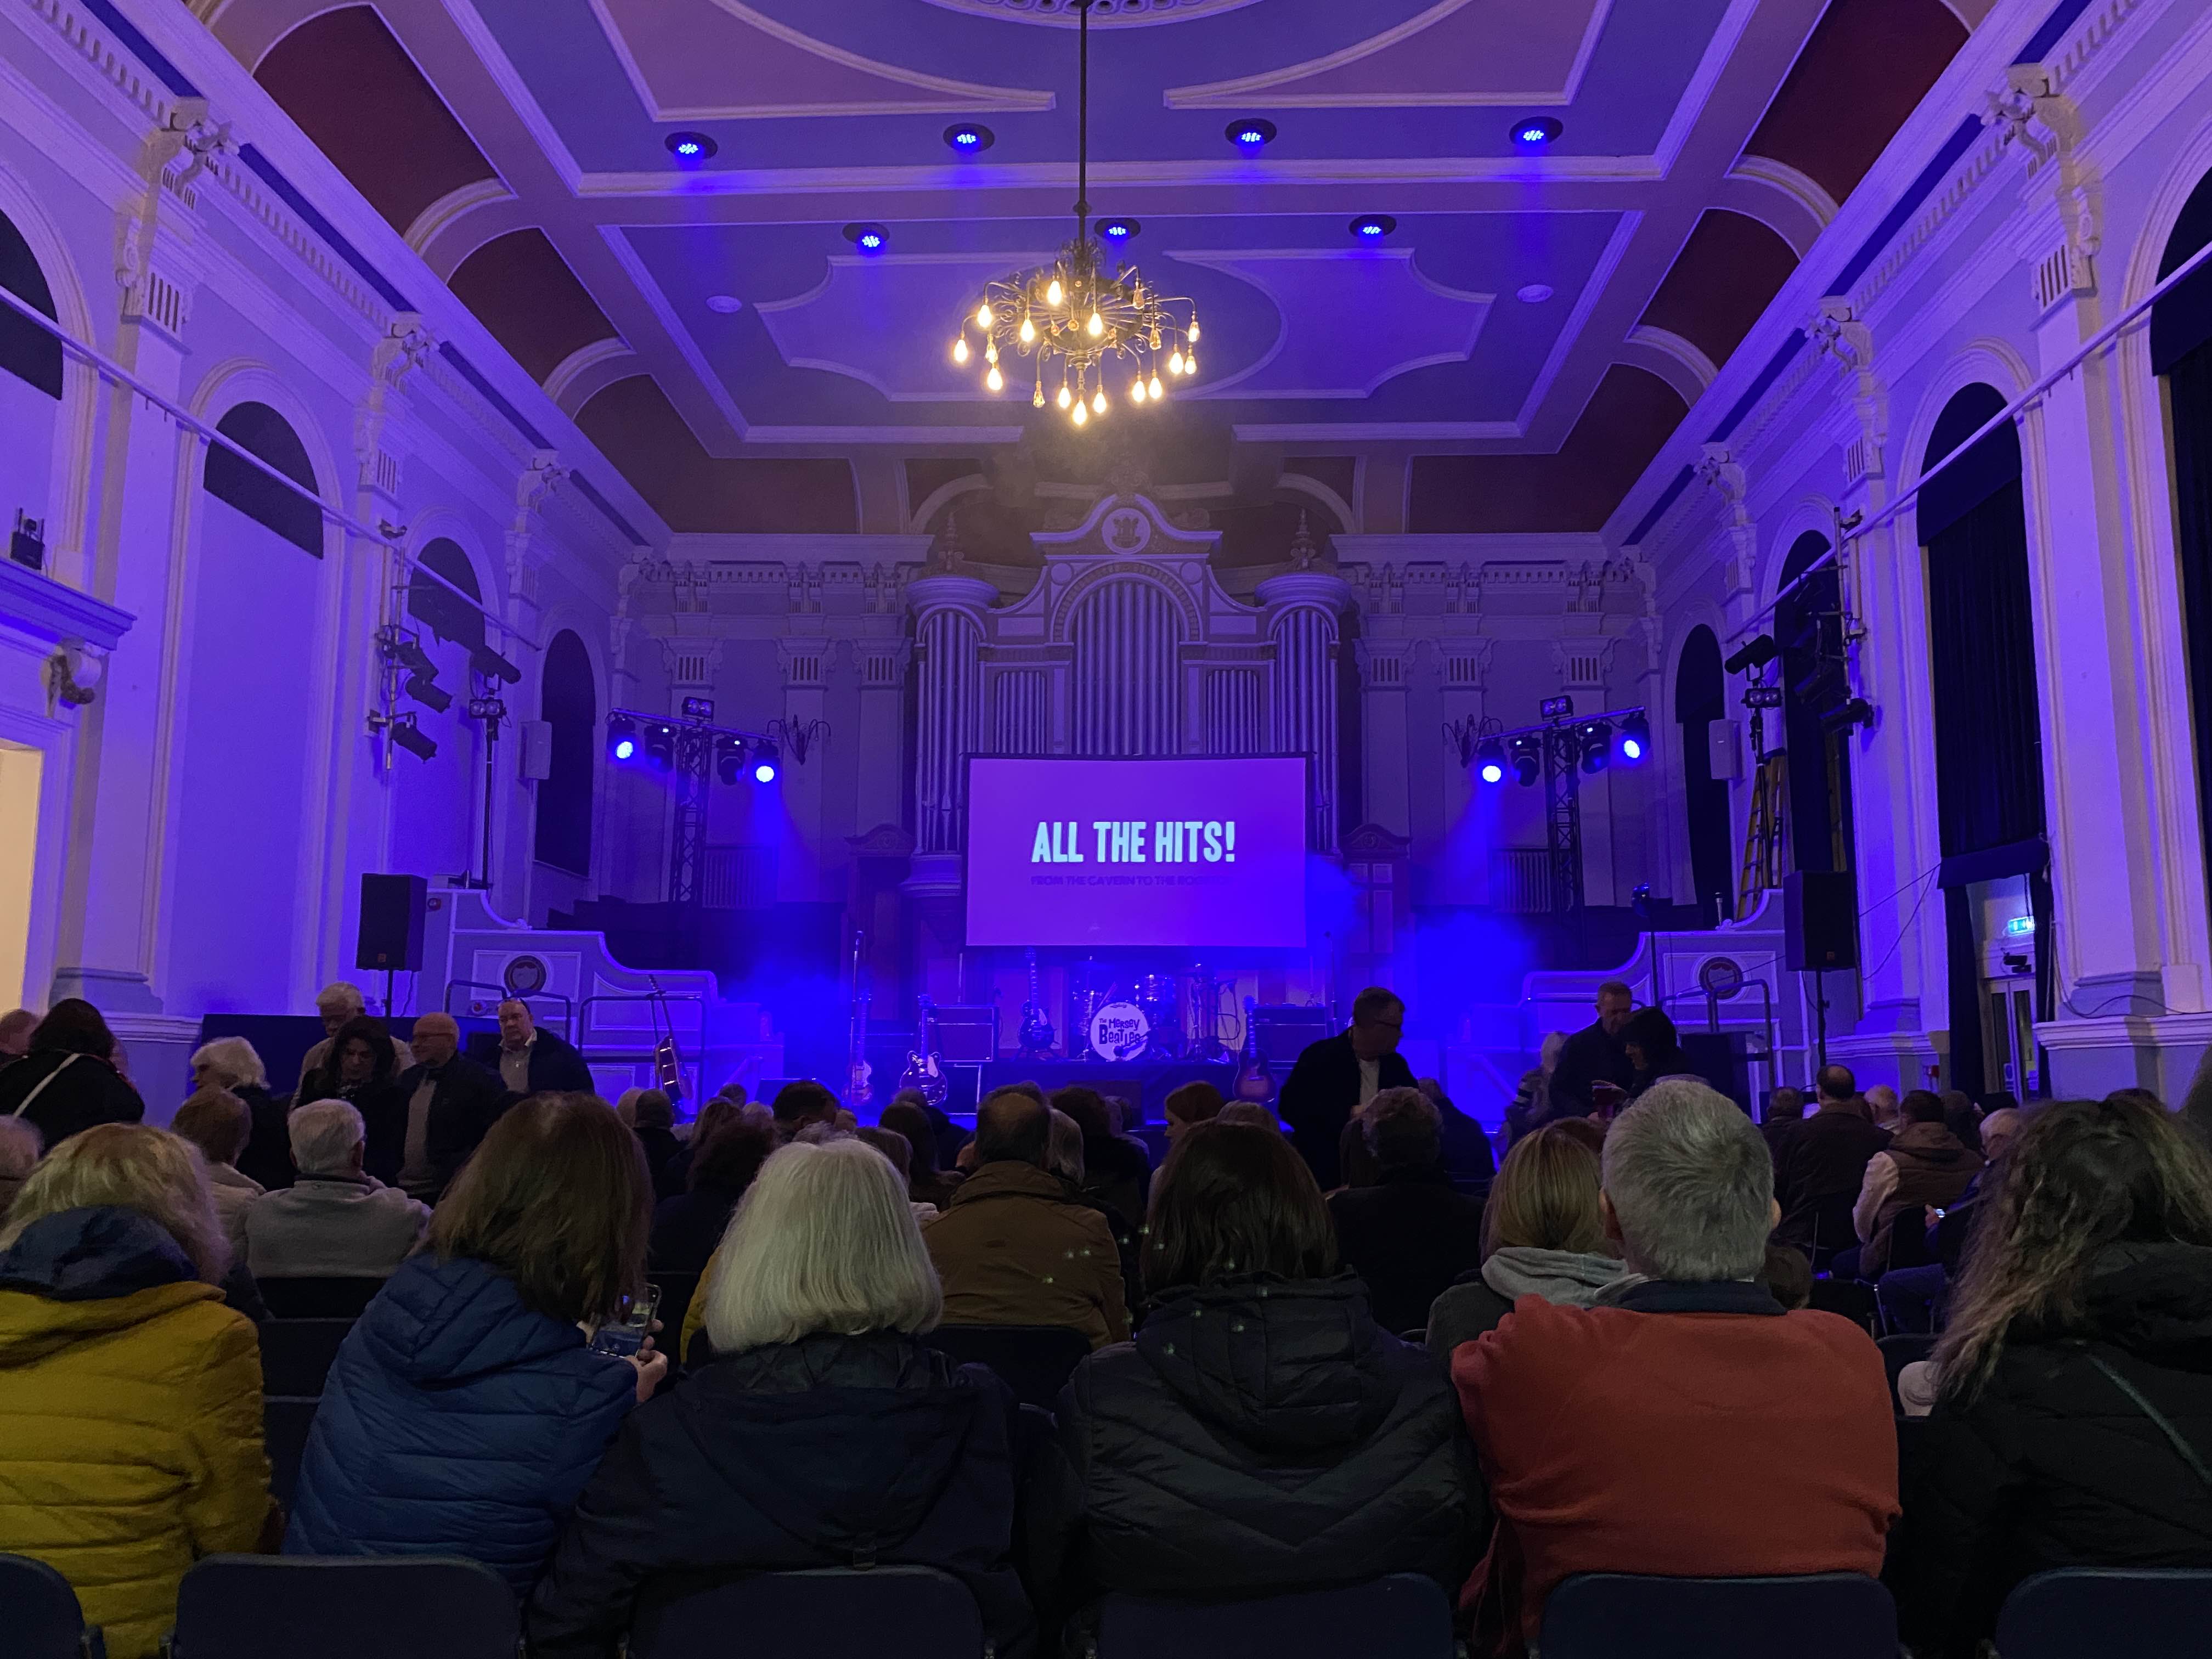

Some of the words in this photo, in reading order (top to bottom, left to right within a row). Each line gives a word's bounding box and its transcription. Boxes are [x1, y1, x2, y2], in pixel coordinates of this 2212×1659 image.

[1031, 821, 1084, 862] ALL
[1093, 821, 1146, 862] THE
[1155, 821, 1235, 862] HITS!
[1031, 876, 1063, 885] FROM
[1065, 876, 1086, 885] THE
[1087, 876, 1135, 885] CAVERN
[1136, 876, 1152, 885] TO
[1153, 876, 1175, 885] THE
